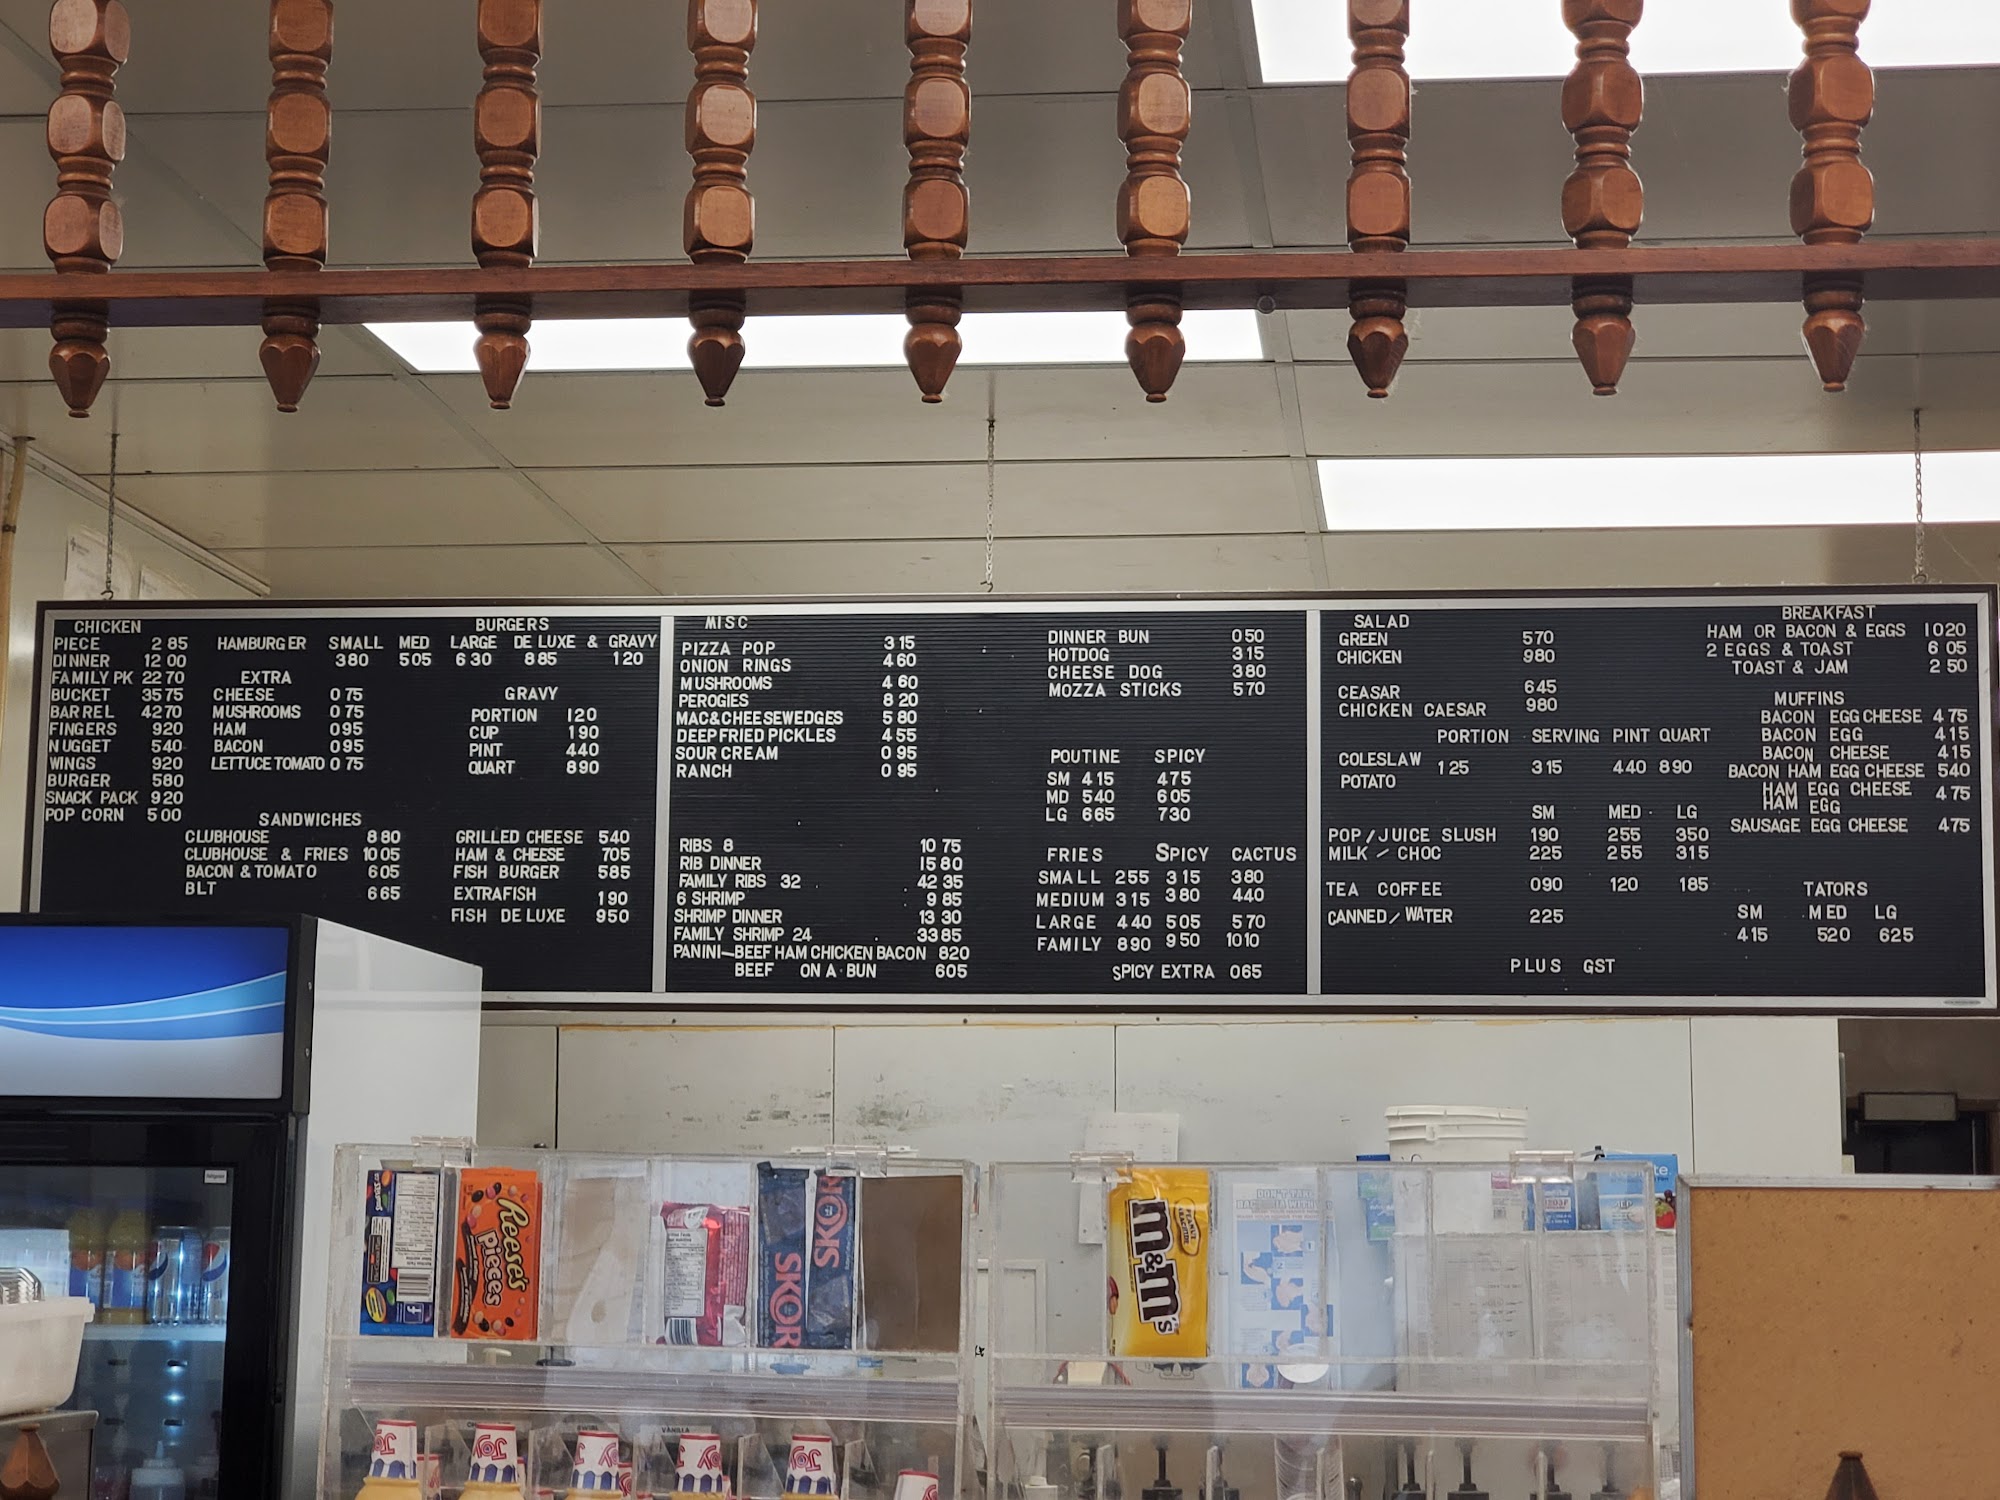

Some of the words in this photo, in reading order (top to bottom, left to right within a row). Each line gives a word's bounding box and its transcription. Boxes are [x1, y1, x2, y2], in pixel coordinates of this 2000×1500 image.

[1782, 605, 1876, 620] BREAKFAST
[74, 620, 141, 634] CHICKEN
[476, 617, 549, 631] BURGERS
[705, 616, 748, 629] MISC
[1354, 614, 1409, 628] SALAD
[1048, 630, 1106, 644] DINNER
[1119, 630, 1149, 643] BUN
[1707, 624, 1741, 639] HAM
[1786, 624, 1836, 638] BACON
[1866, 623, 1906, 637] EGGS
[54, 637, 100, 651] PIECE
[218, 636, 306, 650] HAMBURGER
[329, 636, 384, 650] SMALL
[399, 636, 429, 649] MED
[451, 635, 497, 649] LARGE
[609, 634, 657, 648] GRAVY
[1339, 632, 1388, 646] GREEN
[682, 642, 731, 656] PIZZA
[742, 641, 775, 655] POP
[1048, 647, 1109, 662] HOTDOG
[1725, 642, 1770, 657] EGGS
[1800, 641, 1853, 656] TOAST
[53, 654, 110, 667] DINNER
[1337, 650, 1402, 664] CHICKEN
[680, 659, 728, 673] ONION
[743, 658, 791, 672] RINGS
[1048, 665, 1114, 679] CHEESE
[1129, 665, 1162, 679] DOG
[1732, 660, 1785, 675] TOAST
[1815, 659, 1848, 674] JAM
[52, 671, 109, 685] FAMILY
[241, 670, 292, 684] EXTRA
[681, 676, 772, 691] MUSHROOMS
[51, 688, 111, 702] BUCKET
[213, 688, 274, 701] CHEESE
[505, 686, 558, 700] GRAVY
[1049, 683, 1106, 698] MOZZA
[1120, 682, 1181, 697] STICKS
[1338, 685, 1400, 699] CEASAR
[679, 693, 749, 708] PEROGIES
[1775, 691, 1844, 706] MUFFINS
[50, 705, 114, 719] BARREL
[213, 705, 301, 719] MUSHROOMS
[471, 708, 537, 722] PORTION
[1339, 703, 1412, 717] CHICKEN
[1424, 702, 1486, 717] CAESAR
[1761, 710, 1814, 724] BACON
[1830, 709, 1860, 724] EGG
[1863, 709, 1922, 723] CHEESE
[49, 722, 117, 736] FINGERS
[213, 722, 246, 736] HAM
[469, 726, 499, 740] CUP
[768, 728, 836, 742] PICKLES
[1438, 729, 1509, 743] PORTION
[1532, 728, 1599, 743] SERVING
[1613, 728, 1650, 743] PINT
[1659, 728, 1711, 742] QUART
[1762, 727, 1816, 742] BACON
[1830, 727, 1863, 742] EGG
[49, 739, 111, 753] NUGGET
[214, 739, 263, 753] BACON
[469, 743, 503, 757] PINT
[675, 746, 717, 760] SOUR
[721, 746, 778, 760] CREAM
[1763, 746, 1813, 762] BACON
[1830, 745, 1890, 760] CHEESE
[50, 756, 96, 770] WINGS
[211, 756, 272, 770] LETTUCE
[274, 756, 325, 770] TOMATO
[1051, 749, 1120, 763] POUTINE
[1155, 748, 1205, 763] SPICY
[1339, 752, 1421, 766] COLESLAW
[468, 760, 515, 775] QUART
[676, 764, 732, 778] RANCH
[1729, 764, 1779, 779] BACON
[1788, 763, 1821, 778] HAM
[1830, 764, 1859, 778] EGG
[1865, 763, 1925, 778] CHEESE
[48, 773, 110, 787] BURGER
[1341, 774, 1396, 789] POTATO
[1808, 782, 1839, 796] EGG
[1850, 781, 1912, 796] CHEESE
[45, 790, 92, 804] SNACK
[100, 791, 138, 805] PACK
[1609, 804, 1641, 819] MED
[1810, 797, 1840, 814] EGG
[45, 808, 75, 821] POP
[82, 807, 124, 822] CORN
[259, 812, 361, 826] SANDWICHES
[1730, 818, 1801, 833] SAUSAGE
[1811, 818, 1841, 833] EGG
[1848, 818, 1908, 832] CHEESE
[185, 829, 269, 843] CLUBHOUSE
[456, 830, 519, 844] GRILLED
[526, 830, 583, 844] CHEESE
[1442, 827, 1496, 842] SLUSH
[680, 838, 712, 853] RIBS
[1048, 847, 1102, 862] FRIES
[1156, 843, 1209, 862] SPICY
[1232, 847, 1296, 861] CACTUS
[185, 847, 268, 861] CLUBHOUSE
[304, 847, 348, 861] FRIES
[456, 847, 487, 861] HAM
[513, 847, 565, 862] CHEESE
[1329, 846, 1368, 861] MILK
[1398, 846, 1441, 861] CHOC
[680, 856, 703, 870] RIB
[710, 856, 761, 870] DINNER
[186, 864, 233, 878] BACON
[254, 864, 317, 878] TOMATO
[453, 865, 487, 879] FISH
[499, 865, 559, 879] BURGER
[1038, 869, 1101, 884] SMALL
[185, 881, 217, 895] BLT
[679, 873, 727, 888] FAMILY
[735, 874, 766, 888] RIBS
[1326, 882, 1359, 896] TEA
[1378, 881, 1442, 897] COFFEE
[1803, 881, 1868, 896] TATORS
[691, 891, 745, 906] SHRIMP
[1036, 892, 1104, 907] MEDIUM
[452, 908, 486, 923] FISH
[674, 909, 726, 923] SHRIMP
[732, 909, 782, 923] DINNER
[1809, 904, 1847, 920] MED
[1036, 914, 1096, 929] LARGE
[674, 926, 724, 941] FAMILY
[733, 927, 784, 941] SHRIMP
[1038, 937, 1101, 951] FAMILY
[775, 945, 807, 959] HAM
[811, 945, 873, 960] CHICKEN
[877, 946, 926, 961] BACON
[735, 962, 774, 977] BEEF
[847, 963, 876, 978] BUN
[1112, 964, 1154, 981] SPICY
[1161, 964, 1215, 979] EXTRA
[1511, 958, 1561, 973] PLUS
[1583, 959, 1615, 974] GST
[813, 1176, 848, 1268] SKOR
[497, 1198, 533, 1291] Reese's
[770, 1252, 803, 1348] SKOR
